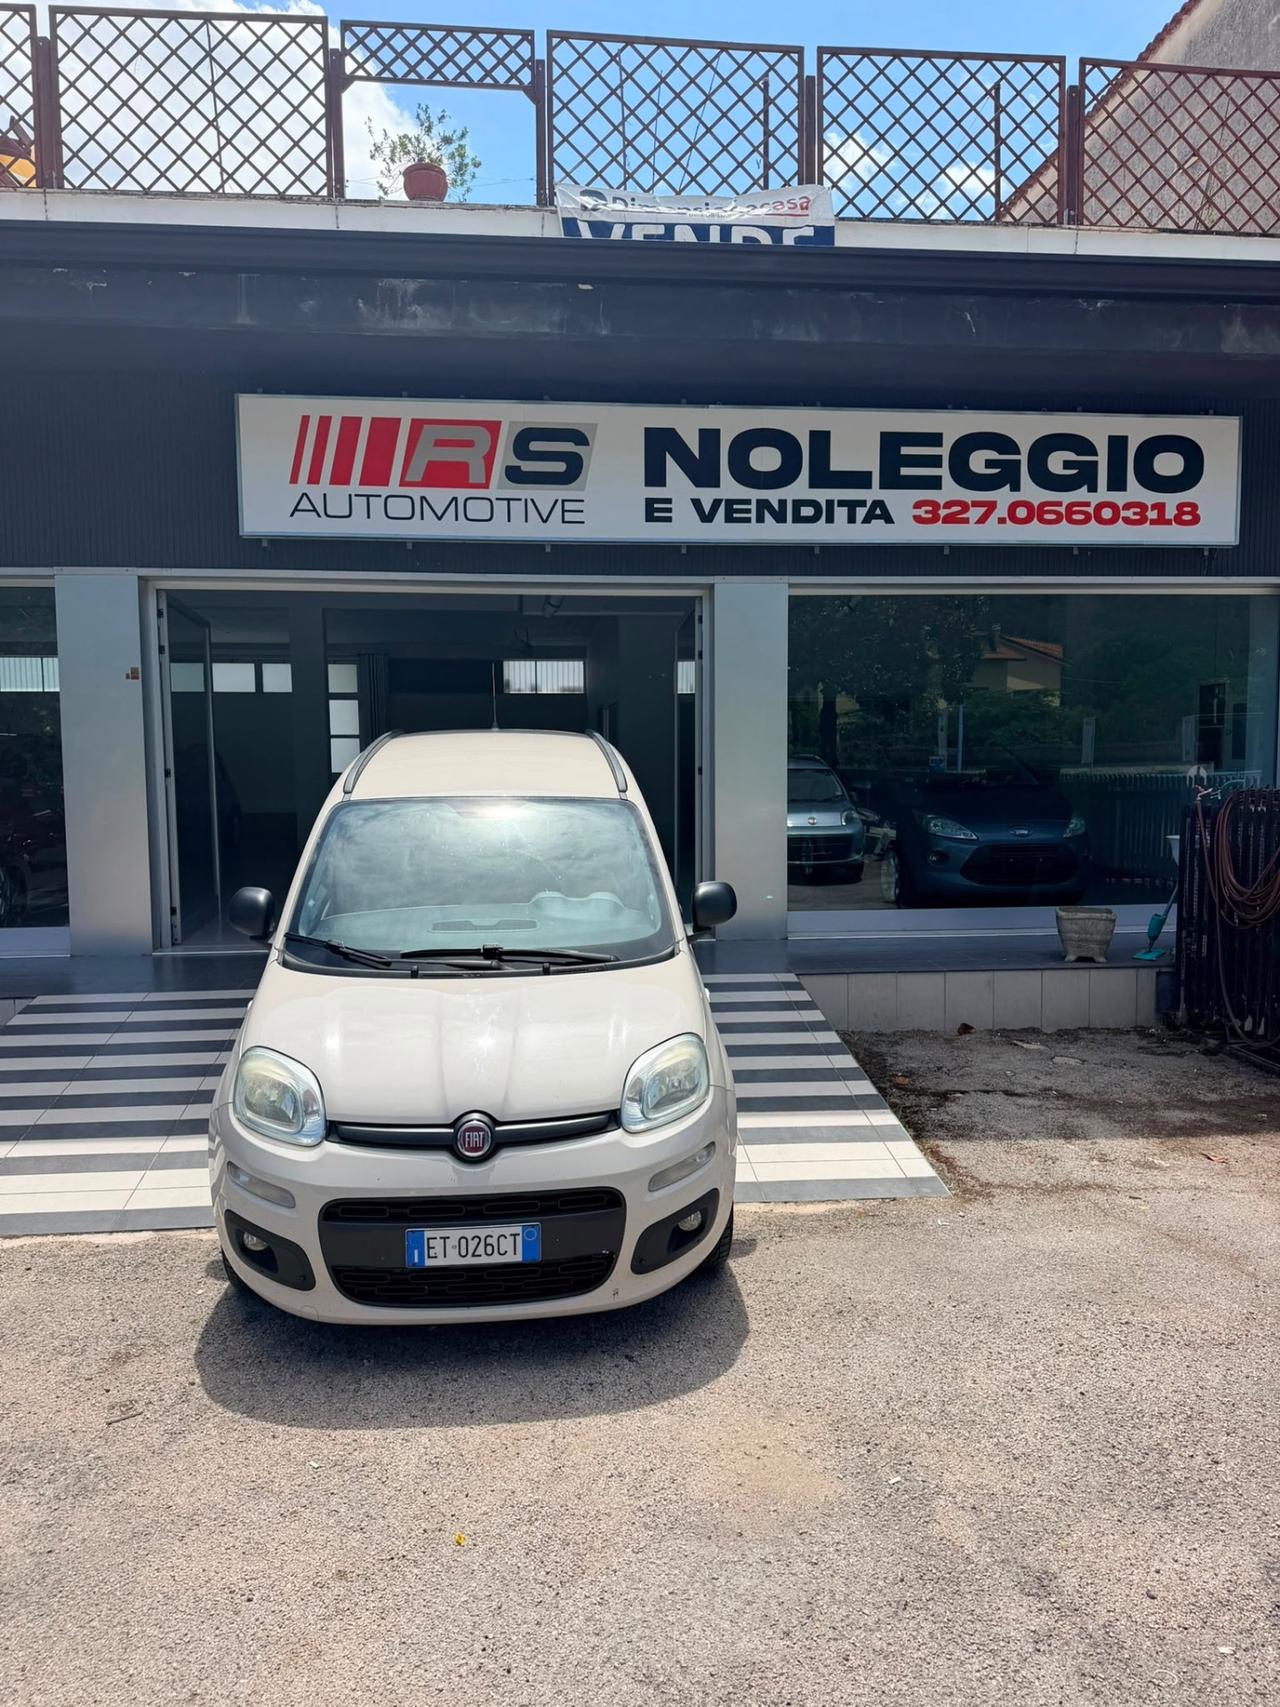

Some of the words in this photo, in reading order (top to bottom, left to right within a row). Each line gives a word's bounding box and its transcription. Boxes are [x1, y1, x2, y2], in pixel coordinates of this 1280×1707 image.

[404, 424, 590, 486] RS
[644, 427, 1204, 493] NOLEGGIO
[289, 492, 585, 524] AUTOMOTIVE
[644, 497, 673, 523] E
[690, 498, 895, 524] VENDITA
[912, 499, 1201, 526] 327.0660318
[465, 1131, 485, 1148] FIAT
